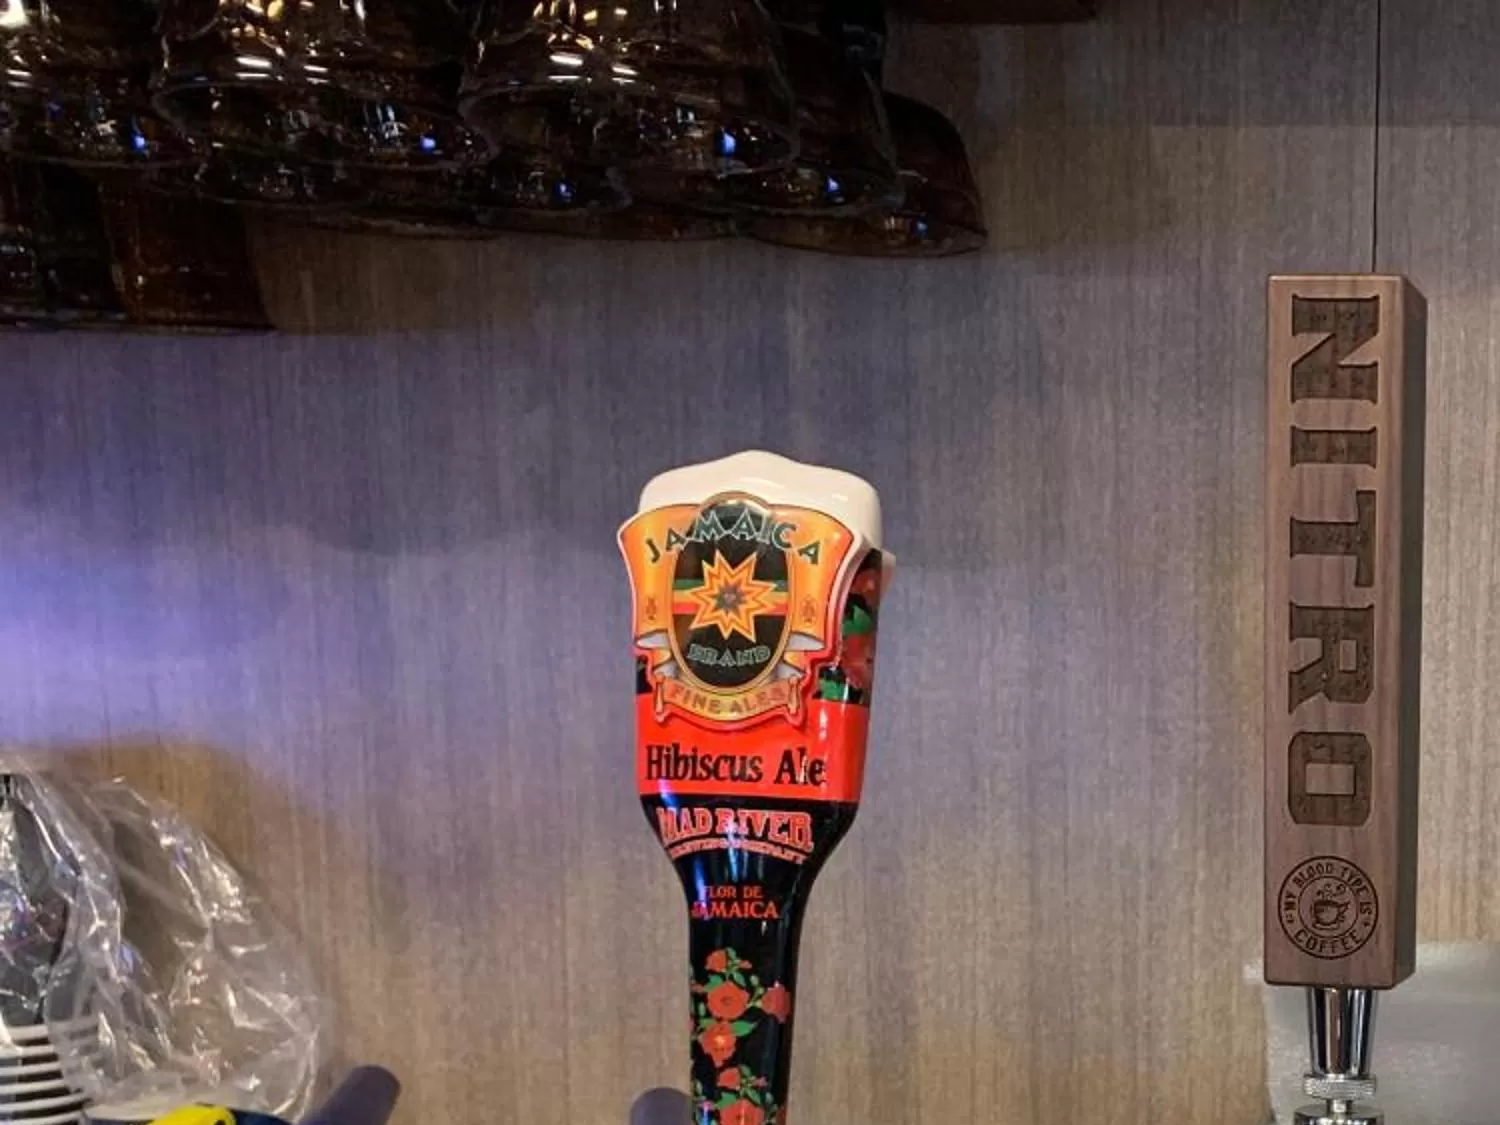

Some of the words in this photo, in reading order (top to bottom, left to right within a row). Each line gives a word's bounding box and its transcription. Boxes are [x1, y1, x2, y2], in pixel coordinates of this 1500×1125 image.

[644, 507, 823, 566] JAMAICA
[1288, 294, 1380, 827] NITRO
[686, 643, 772, 668] BRAND
[645, 743, 763, 783] Hibiscus
[774, 747, 827, 787] Ale
[656, 807, 713, 849] MAD
[715, 808, 815, 851] RIVER
[691, 901, 780, 920] JAMAICA
[703, 885, 737, 899] FLOR
[743, 885, 763, 898] DE
[1284, 890, 1297, 911] MY
[1292, 862, 1333, 888] BLOOD
[1340, 865, 1369, 897] TYPE
[1360, 901, 1373, 916] IS
[1294, 929, 1362, 954] COFFEE
